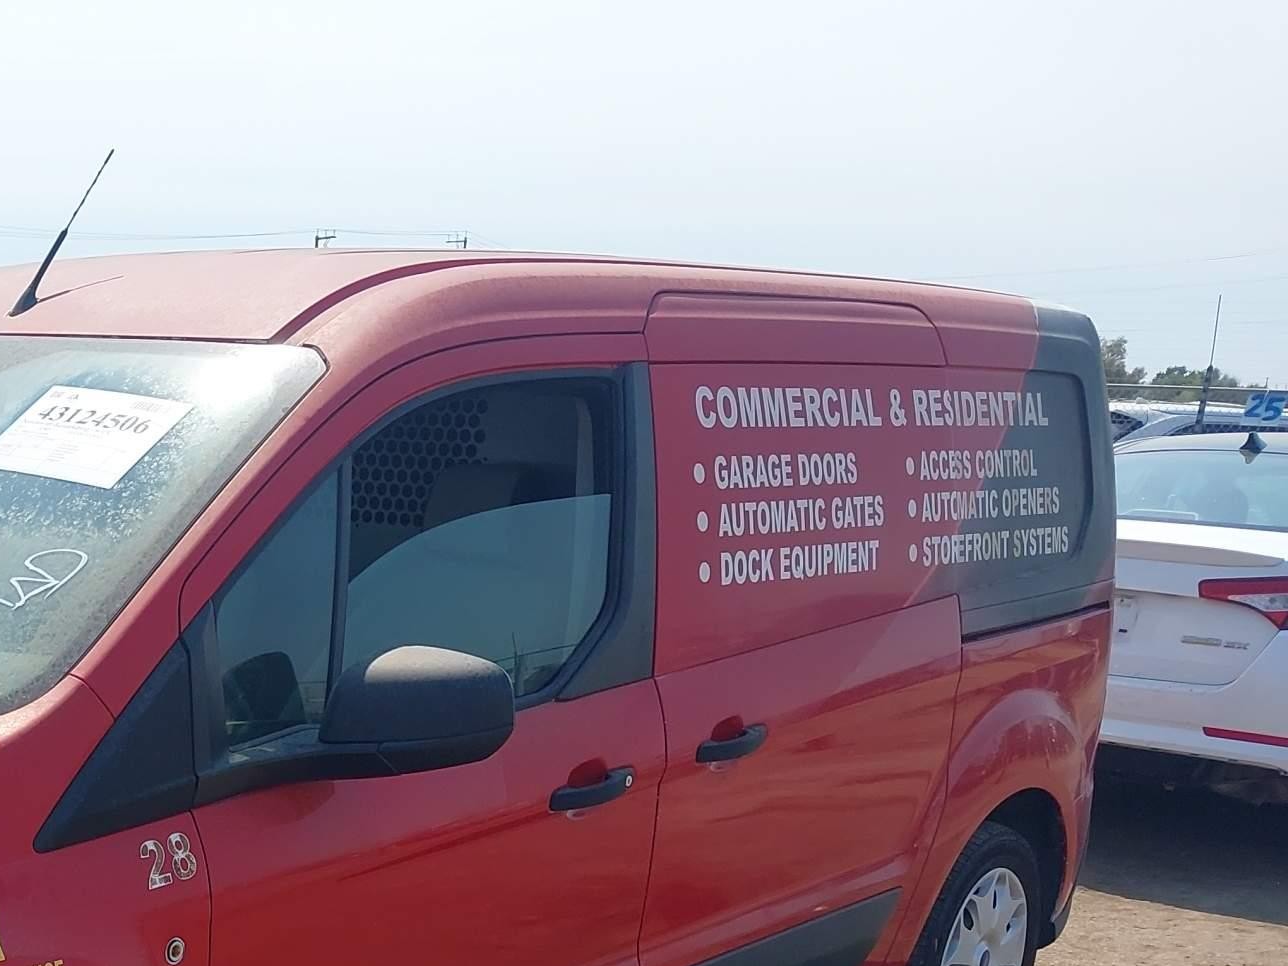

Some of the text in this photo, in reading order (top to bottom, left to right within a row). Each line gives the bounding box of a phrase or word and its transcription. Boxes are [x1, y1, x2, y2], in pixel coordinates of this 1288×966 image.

[38, 405, 152, 434] 43124506
[695, 385, 1049, 428] COMMERCIAL & RESIDENTIAL
[1244, 393, 1287, 421] 25
[714, 452, 858, 489] GARAGE DOORS
[920, 449, 1038, 480] ACCESS CONTROL
[719, 495, 884, 536] AUTOMATIC GATES
[922, 486, 1060, 523] AUTOMATIC OPENERS
[720, 540, 880, 586] DOCK EQUIPMENT
[922, 526, 1069, 567] STOREFRONT SYSTEMS
[140, 832, 197, 890] 28
